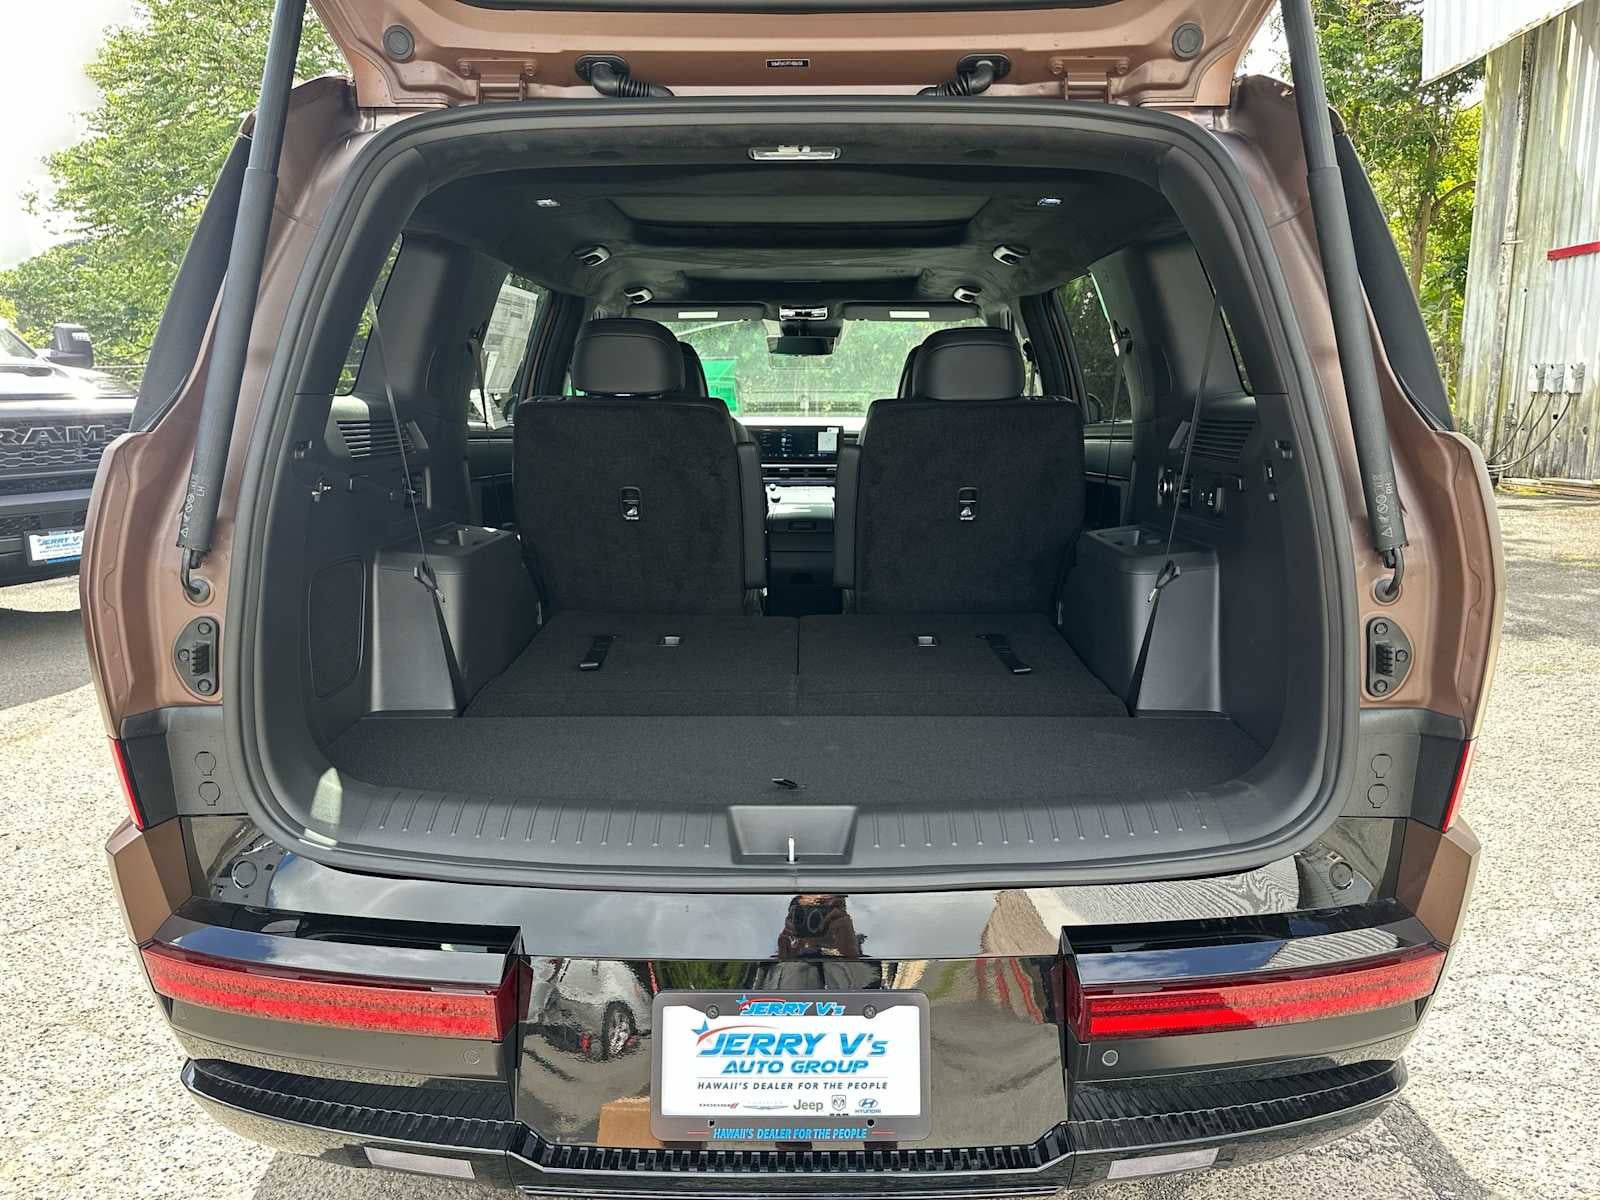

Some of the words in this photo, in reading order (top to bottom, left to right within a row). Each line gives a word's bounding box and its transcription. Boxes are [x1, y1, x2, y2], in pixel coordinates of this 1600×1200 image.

[0, 424, 106, 445] RAM
[739, 1001, 813, 1016] JERRY
[815, 1001, 847, 1016] V's
[697, 1033, 827, 1057] JERRY
[839, 1033, 889, 1057] V's
[722, 1060, 784, 1074] AUTO
[790, 1060, 870, 1074] GROUP
[697, 1082, 748, 1090] HAWAII'S
[752, 1082, 793, 1090] DEALER
[797, 1082, 820, 1090] FOR
[823, 1082, 843, 1090] THE
[847, 1082, 889, 1090] PEOPLE
[793, 1099, 824, 1112] Jeep
[713, 1128, 754, 1140] HAWAII'S
[757, 1128, 792, 1140] DEALER
[793, 1128, 811, 1140] FOR
[812, 1128, 831, 1140] THE
[832, 1128, 868, 1140] PEOPLE
